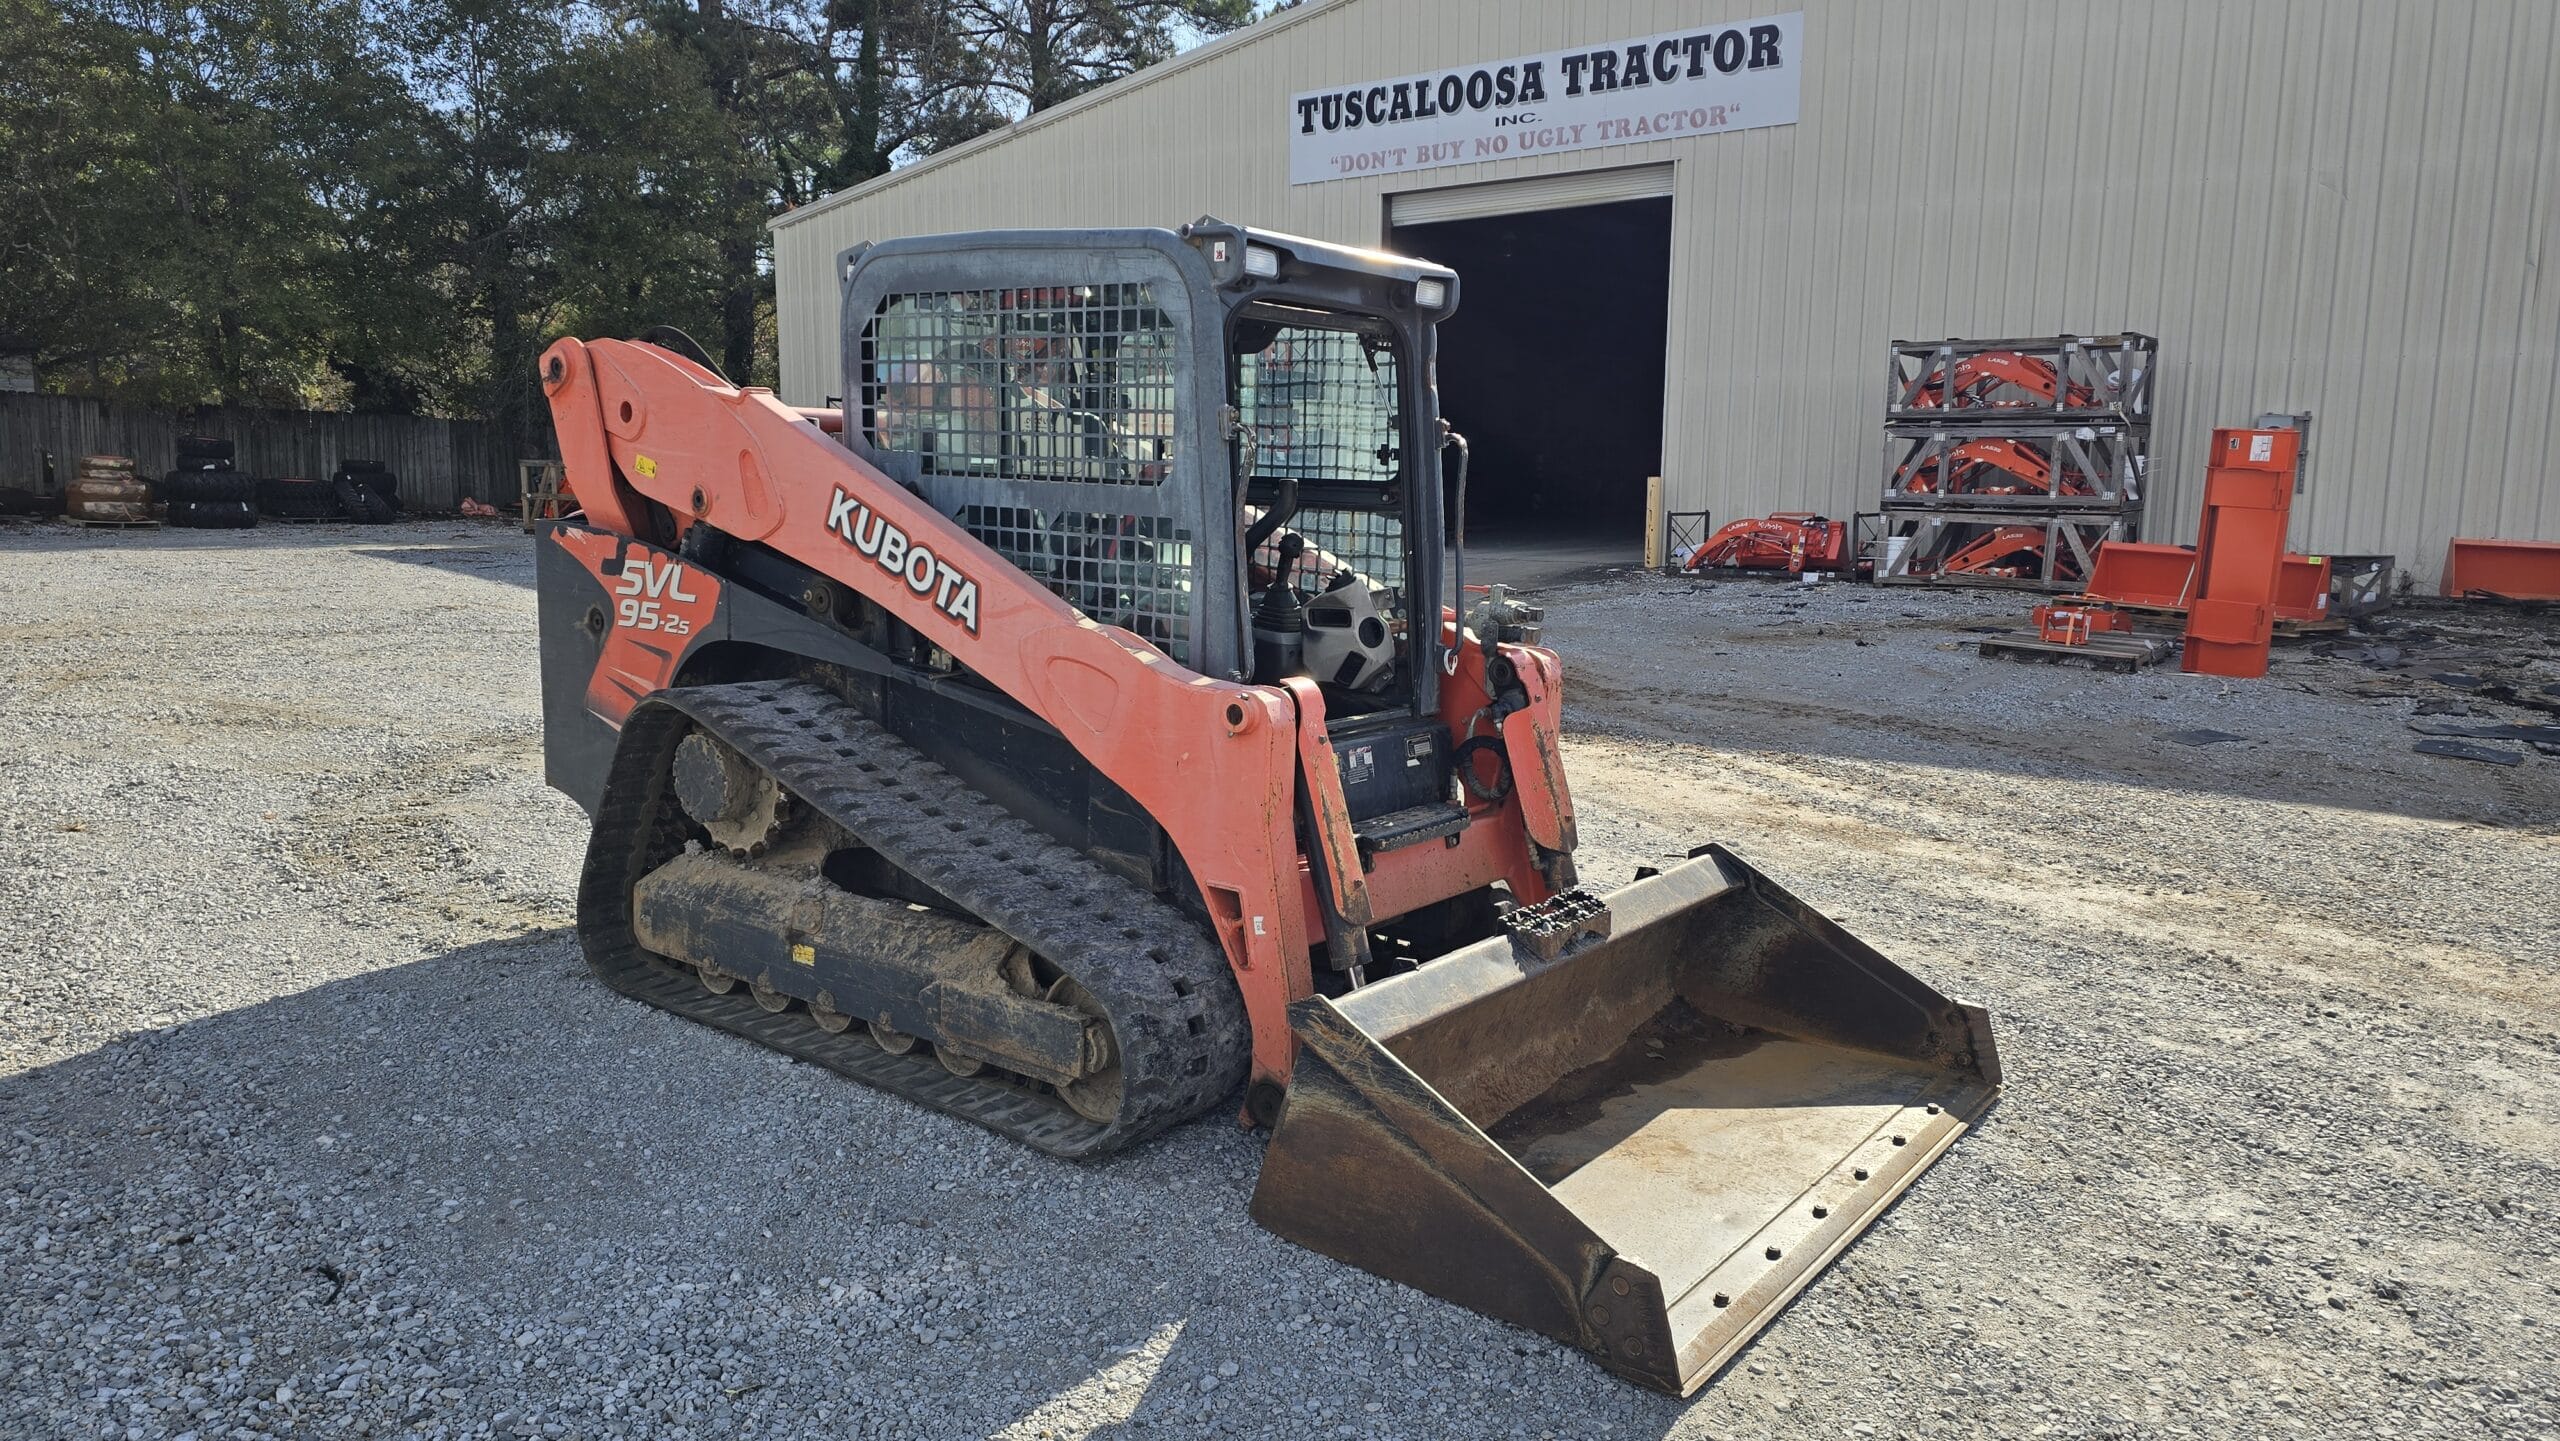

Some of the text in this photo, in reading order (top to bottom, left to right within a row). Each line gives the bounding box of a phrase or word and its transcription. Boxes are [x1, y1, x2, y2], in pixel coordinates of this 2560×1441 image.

[1298, 24, 1782, 135] TUSCALOOSA TRACTOR
[1495, 112, 1543, 127] INC.
[1330, 147, 1407, 173] “DON'T
[1416, 140, 1465, 164] BUY
[1475, 134, 1509, 157] NO
[1518, 124, 1587, 150] UGLY
[615, 559, 697, 603] SVL
[827, 486, 978, 634] KUBOTA
